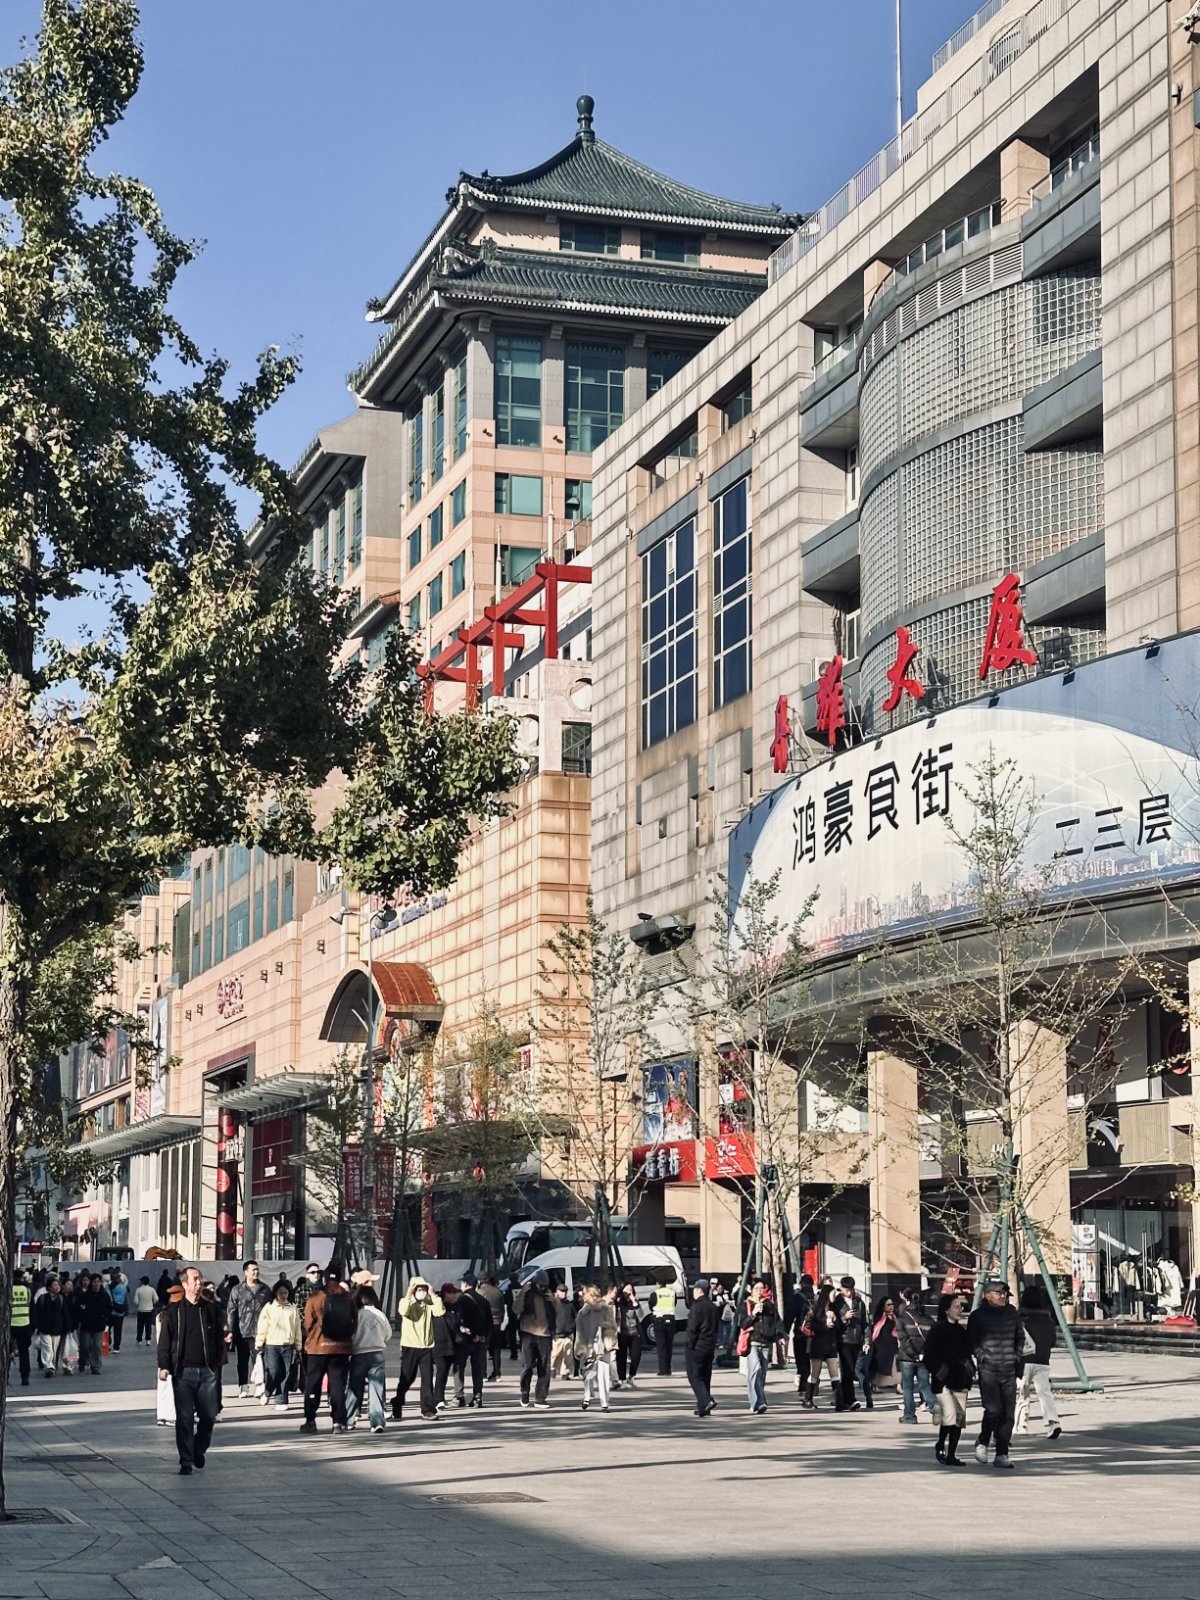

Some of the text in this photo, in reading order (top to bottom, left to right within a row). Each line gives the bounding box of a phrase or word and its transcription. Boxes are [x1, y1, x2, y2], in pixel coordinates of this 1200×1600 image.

[791, 742, 954, 871] 鸿豪食街
[1053, 792, 1173, 860] 二三层
